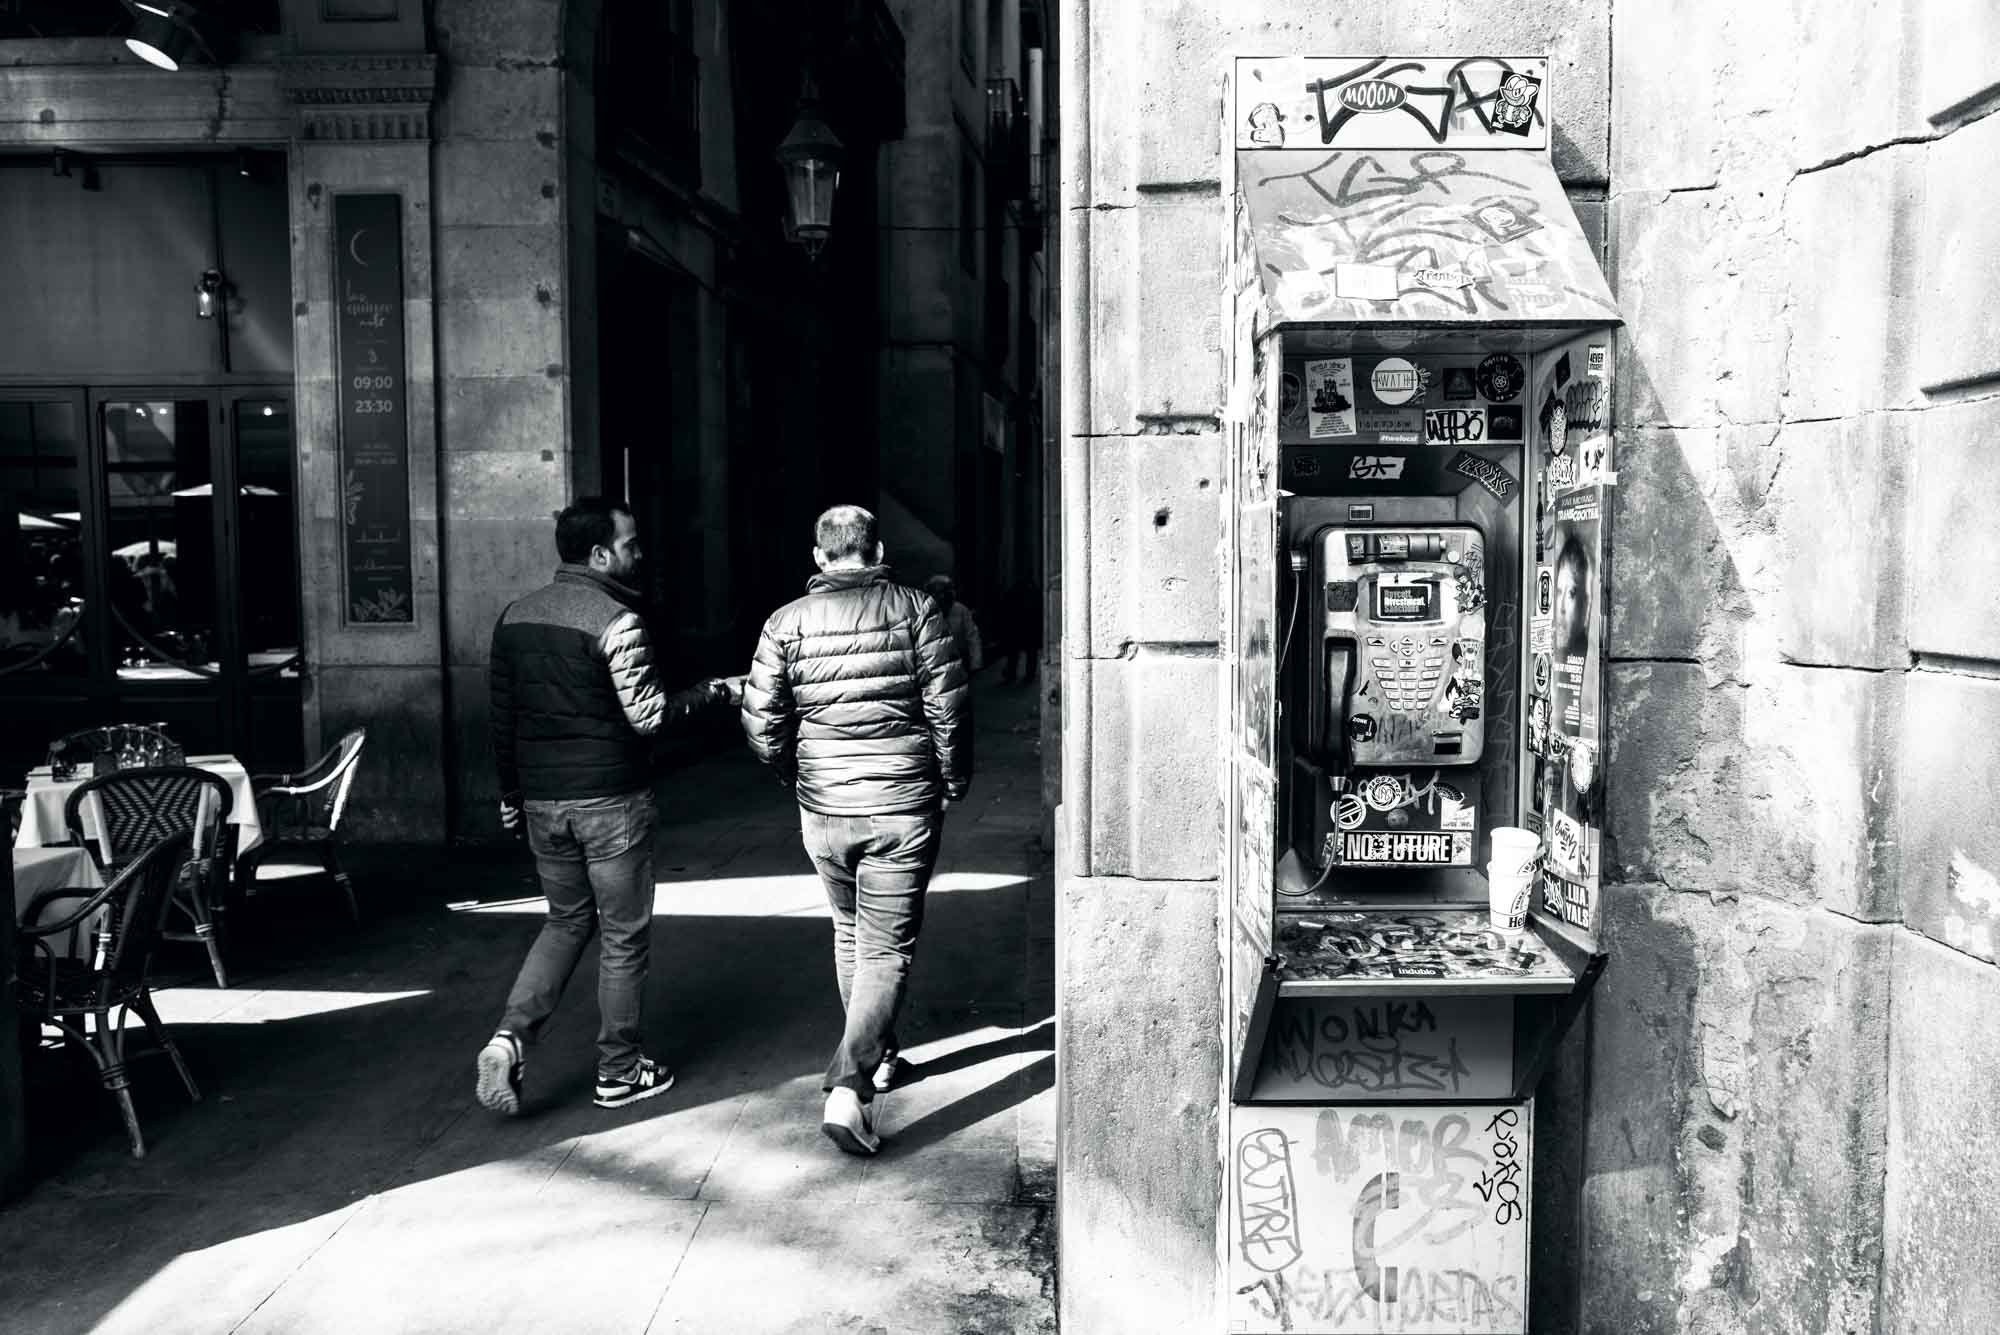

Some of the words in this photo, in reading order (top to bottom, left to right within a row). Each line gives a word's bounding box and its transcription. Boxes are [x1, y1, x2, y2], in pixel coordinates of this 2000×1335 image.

[353, 376, 393, 391] 09:00
[354, 400, 393, 414] 23:30
[638, 1069, 655, 1087] N
